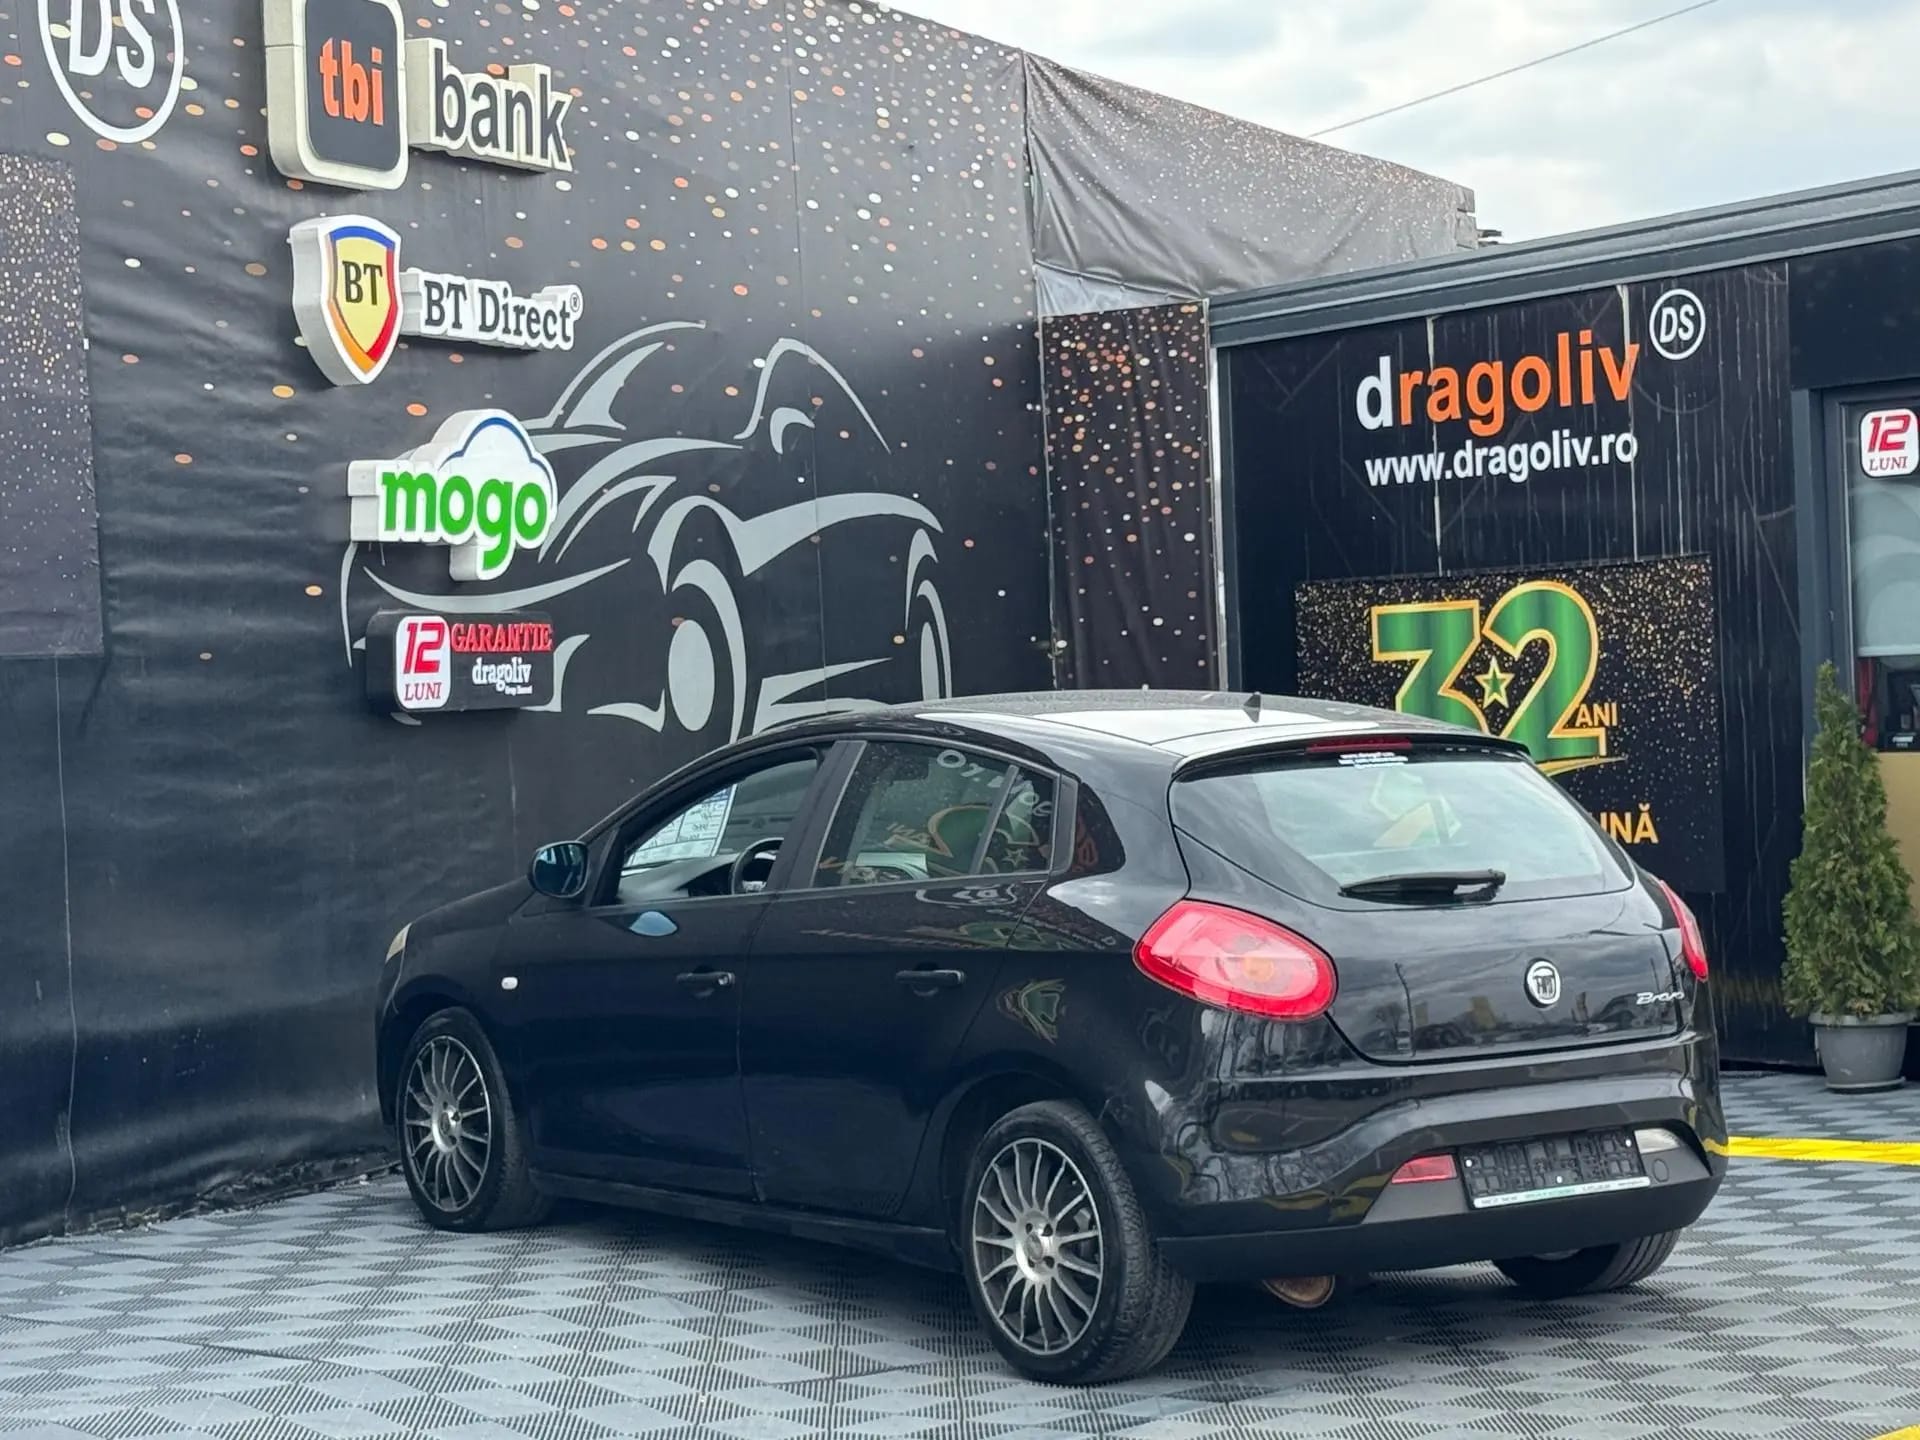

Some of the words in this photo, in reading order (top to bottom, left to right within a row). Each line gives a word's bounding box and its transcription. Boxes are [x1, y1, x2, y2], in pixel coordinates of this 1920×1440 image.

[68, 0, 155, 88] DS
[319, 37, 384, 126] tbi
[434, 40, 570, 165] bank
[342, 260, 383, 305] BT
[424, 280, 467, 329] BT
[1660, 303, 1695, 345] DS
[1356, 329, 1640, 436] dragoliv
[1365, 428, 1638, 486] www.dragoliv.ro
[1868, 414, 1911, 453] 12
[1869, 456, 1908, 471] LUNI
[381, 470, 548, 570] mogo
[403, 621, 445, 674] 12
[1371, 579, 1607, 764] 32
[404, 681, 442, 701] LUNI
[472, 656, 532, 692] dragoliv
[1575, 702, 1618, 727] ANI
